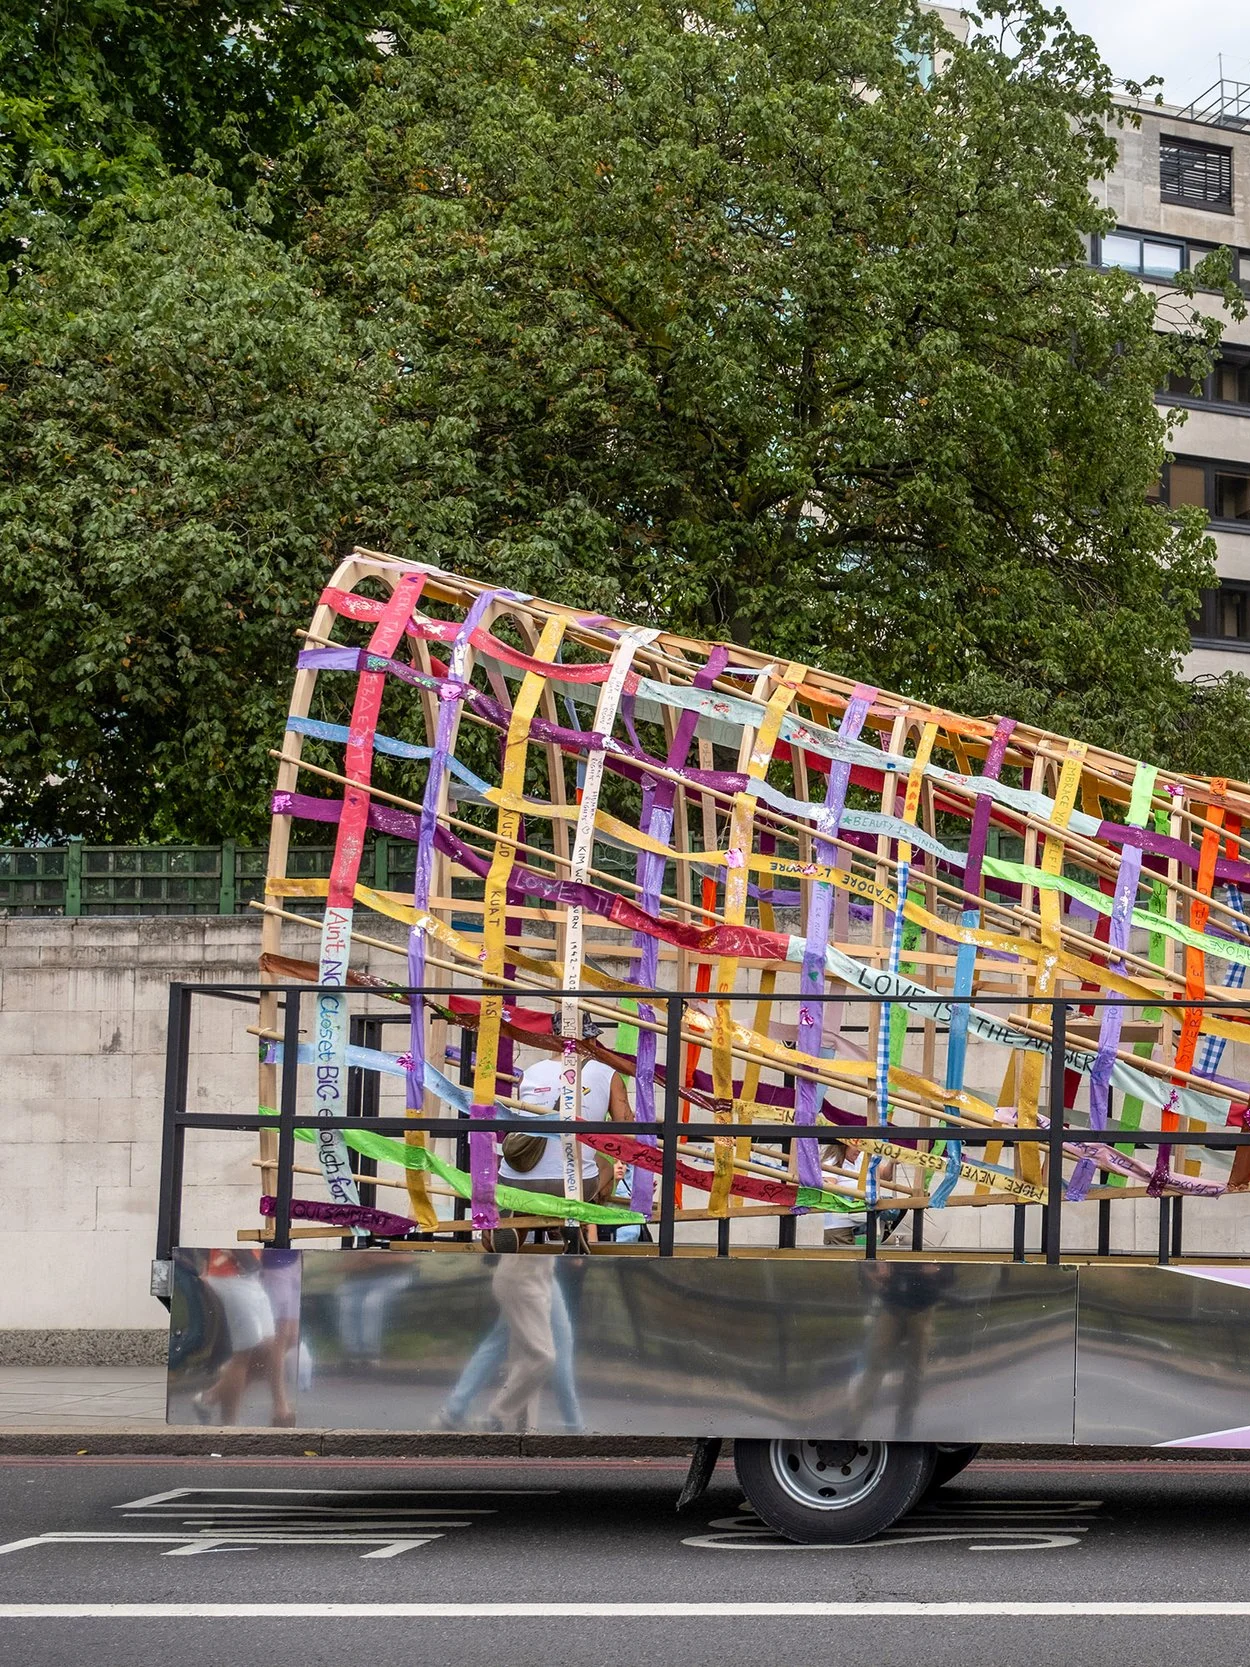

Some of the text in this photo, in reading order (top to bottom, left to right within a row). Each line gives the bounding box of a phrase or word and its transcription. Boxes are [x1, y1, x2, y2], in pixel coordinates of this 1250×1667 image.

[853, 813, 899, 832] BEAUTY
[575, 845, 588, 866] KIM
[841, 873, 896, 905] J'ADORE
[488, 889, 502, 927] KUAT
[324, 910, 348, 953] Ain't
[856, 968, 928, 1012] LOVE
[931, 1001, 955, 1023] IS
[975, 1013, 1016, 1045] THE
[317, 996, 341, 1062] Closet
[312, 1108, 347, 1175] eough
[603, 1141, 624, 1156] es
[873, 1142, 902, 1160] FOR
[329, 1176, 352, 1205] for
